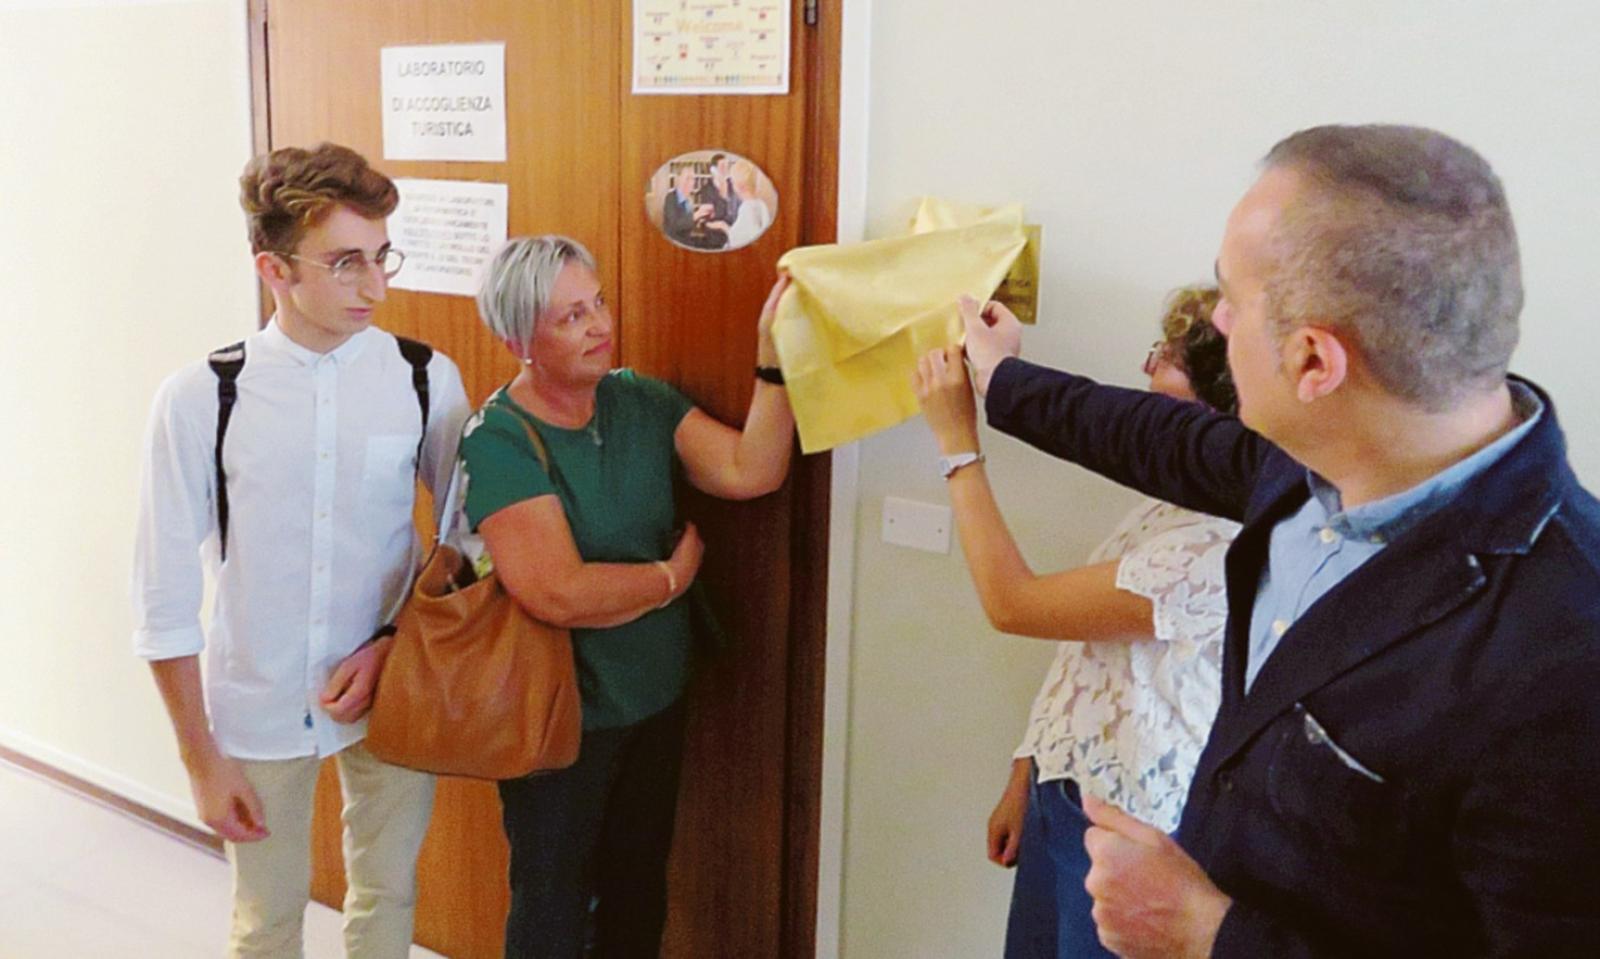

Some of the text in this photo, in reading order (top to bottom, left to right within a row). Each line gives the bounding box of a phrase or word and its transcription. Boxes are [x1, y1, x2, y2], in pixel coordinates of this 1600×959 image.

[397, 60, 486, 77] LABORATORIO
[392, 96, 492, 112] DI ACCOGLIENZA
[411, 121, 474, 137] TURISTICA
